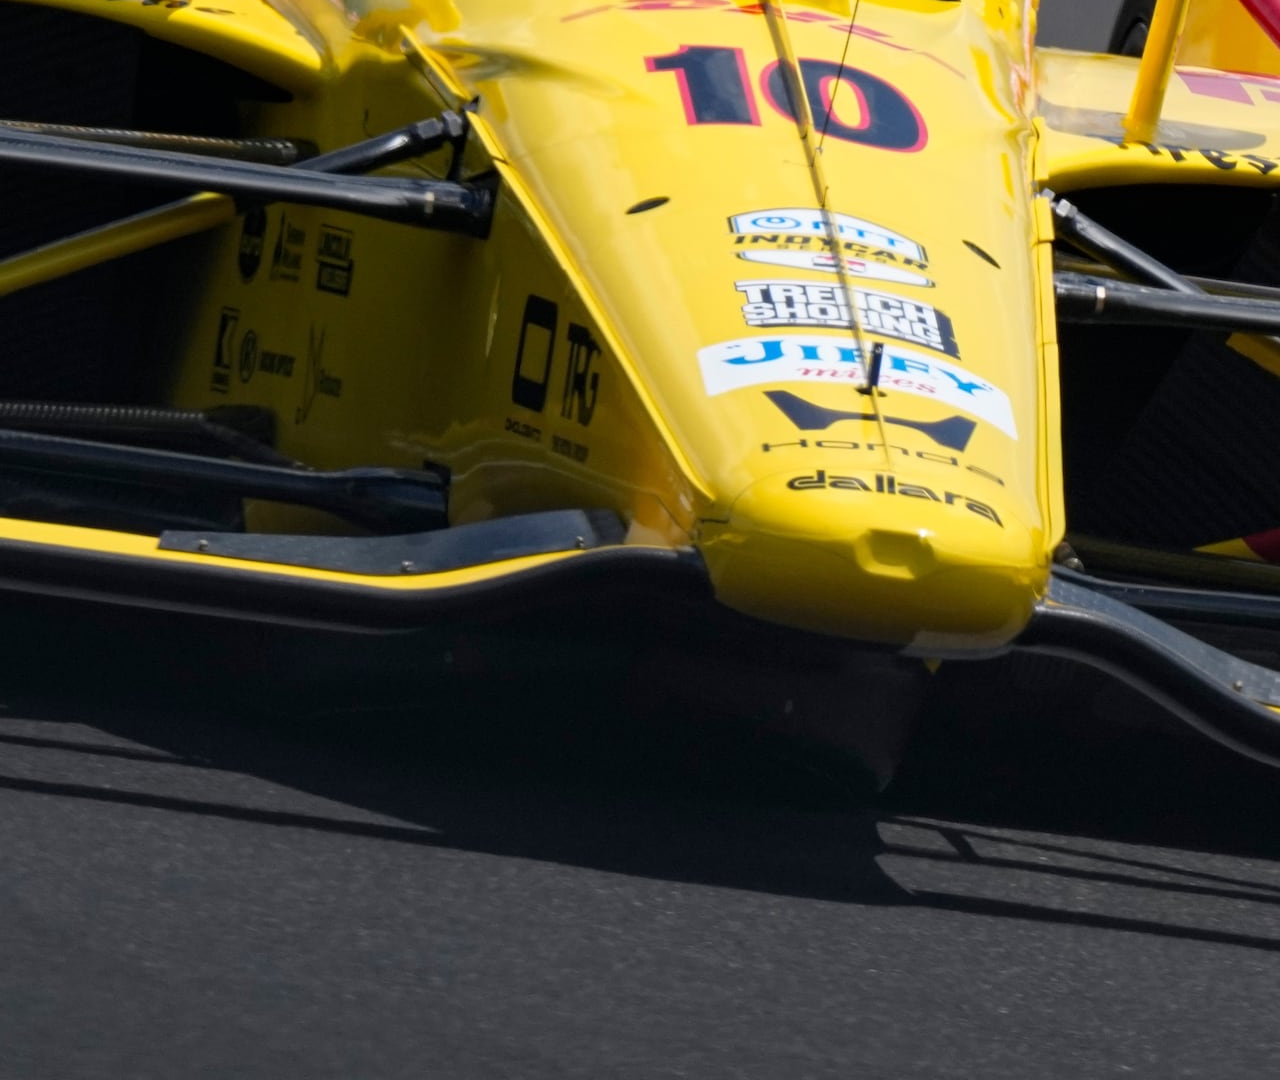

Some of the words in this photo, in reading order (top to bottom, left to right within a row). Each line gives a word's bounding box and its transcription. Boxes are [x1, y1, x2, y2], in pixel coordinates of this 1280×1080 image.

[643, 43, 929, 153] 10
[733, 234, 930, 271] INDYCAR
[785, 469, 1005, 529] dallara
